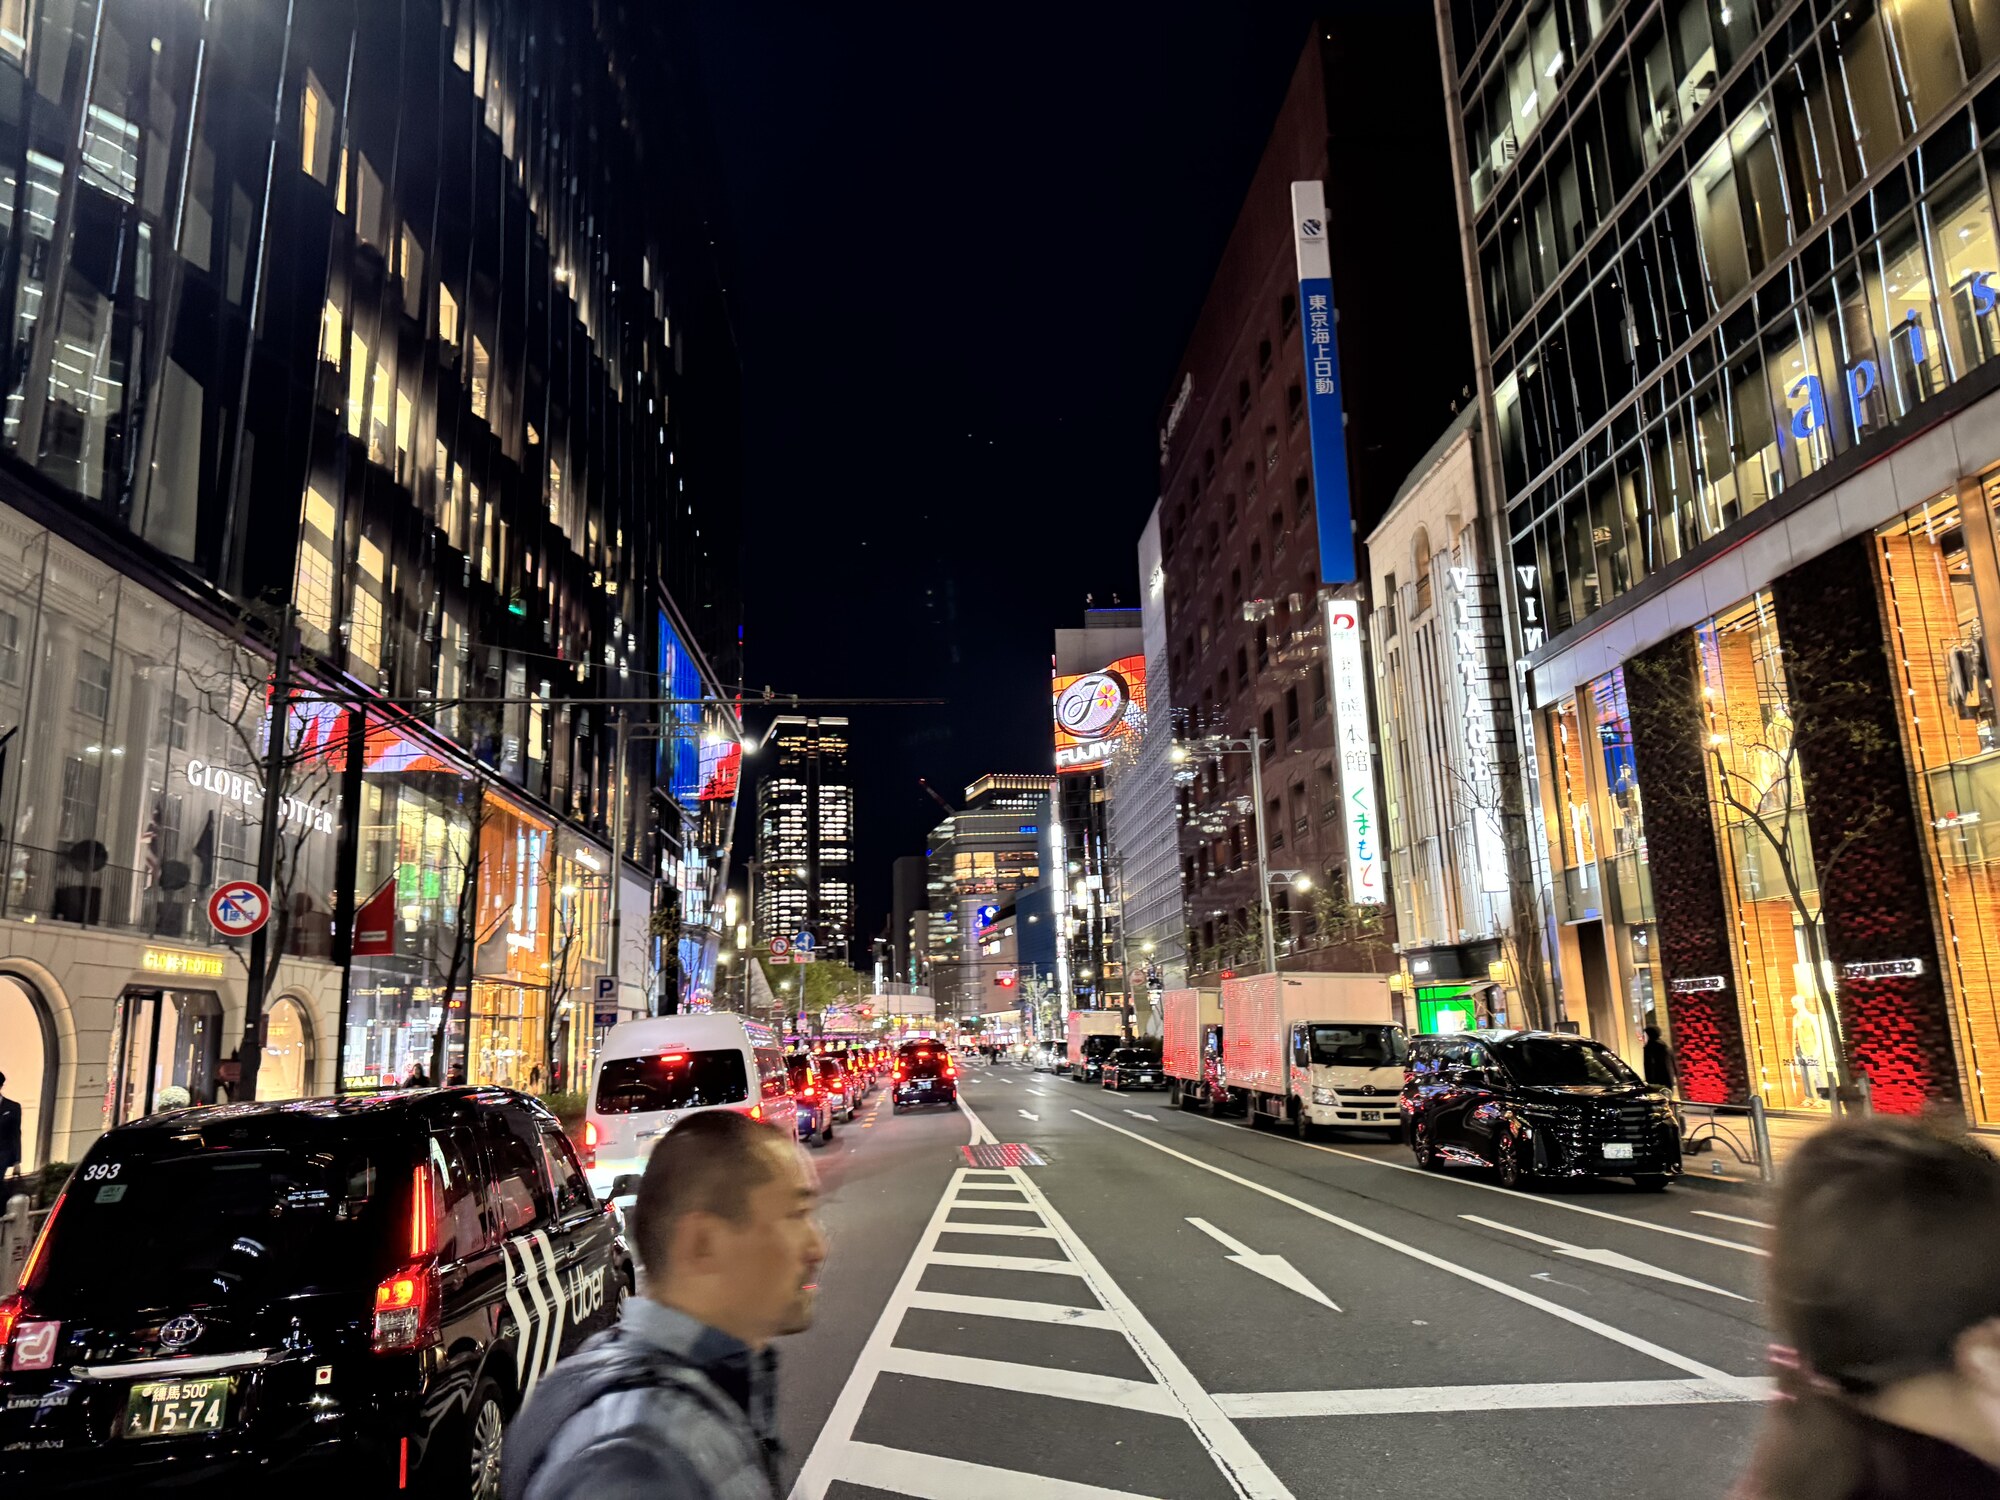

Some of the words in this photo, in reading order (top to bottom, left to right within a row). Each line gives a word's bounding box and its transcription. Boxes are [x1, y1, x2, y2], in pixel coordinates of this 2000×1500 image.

[1308, 294, 1335, 395] 東京海上日動
[1450, 566, 1491, 782] VINTAGE
[187, 759, 333, 835] GLOBE-OTTER
[143, 950, 224, 975] GLOBE-TROTTER
[599, 979, 614, 999] P
[344, 1076, 378, 1088] TAXI
[83, 1163, 122, 1182] 393
[568, 1263, 608, 1326] Uber
[7, 1396, 69, 1410] LIMOTAXI
[152, 1386, 181, 1402] 練馬
[181, 1384, 208, 1400] 500
[149, 1398, 221, 1433] 15-74
